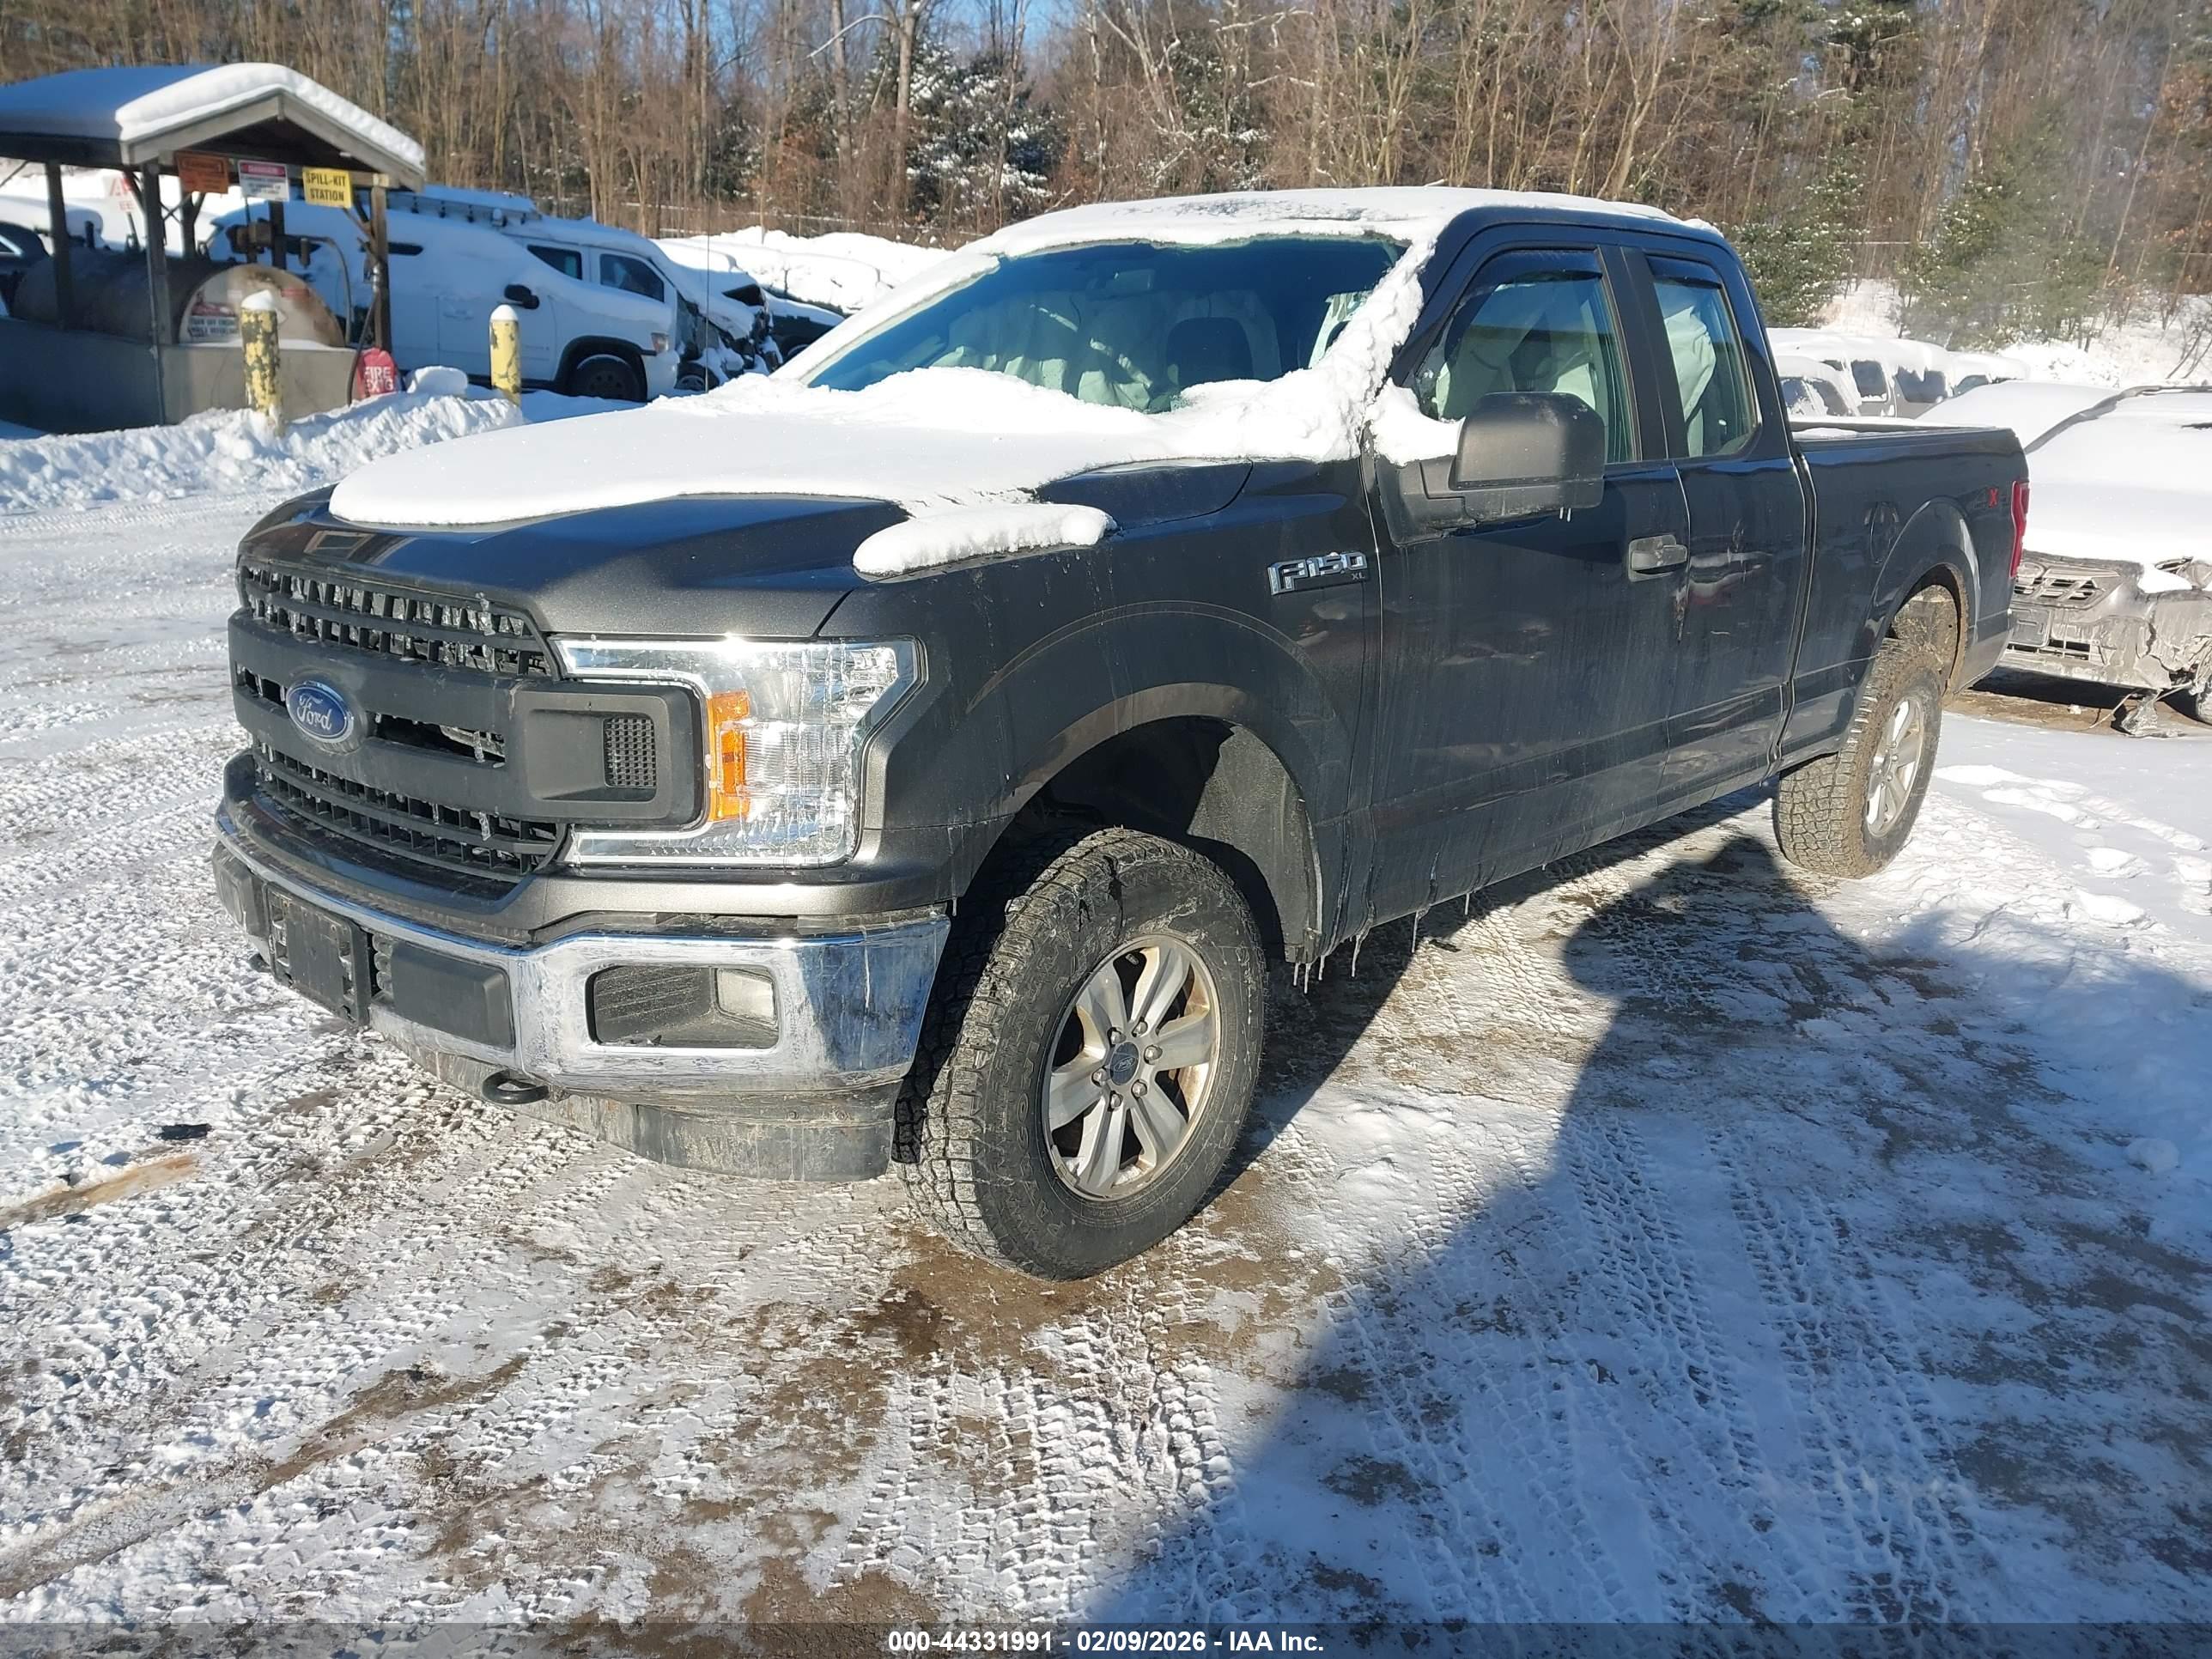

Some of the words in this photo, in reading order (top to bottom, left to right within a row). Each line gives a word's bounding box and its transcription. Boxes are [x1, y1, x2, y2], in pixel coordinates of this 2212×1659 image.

[306, 172, 345, 186] SPILL-KIT
[310, 188, 344, 201] STATION
[364, 366, 392, 380] FIRE
[1352, 571, 1365, 580] XL
[296, 693, 332, 730] Ford
